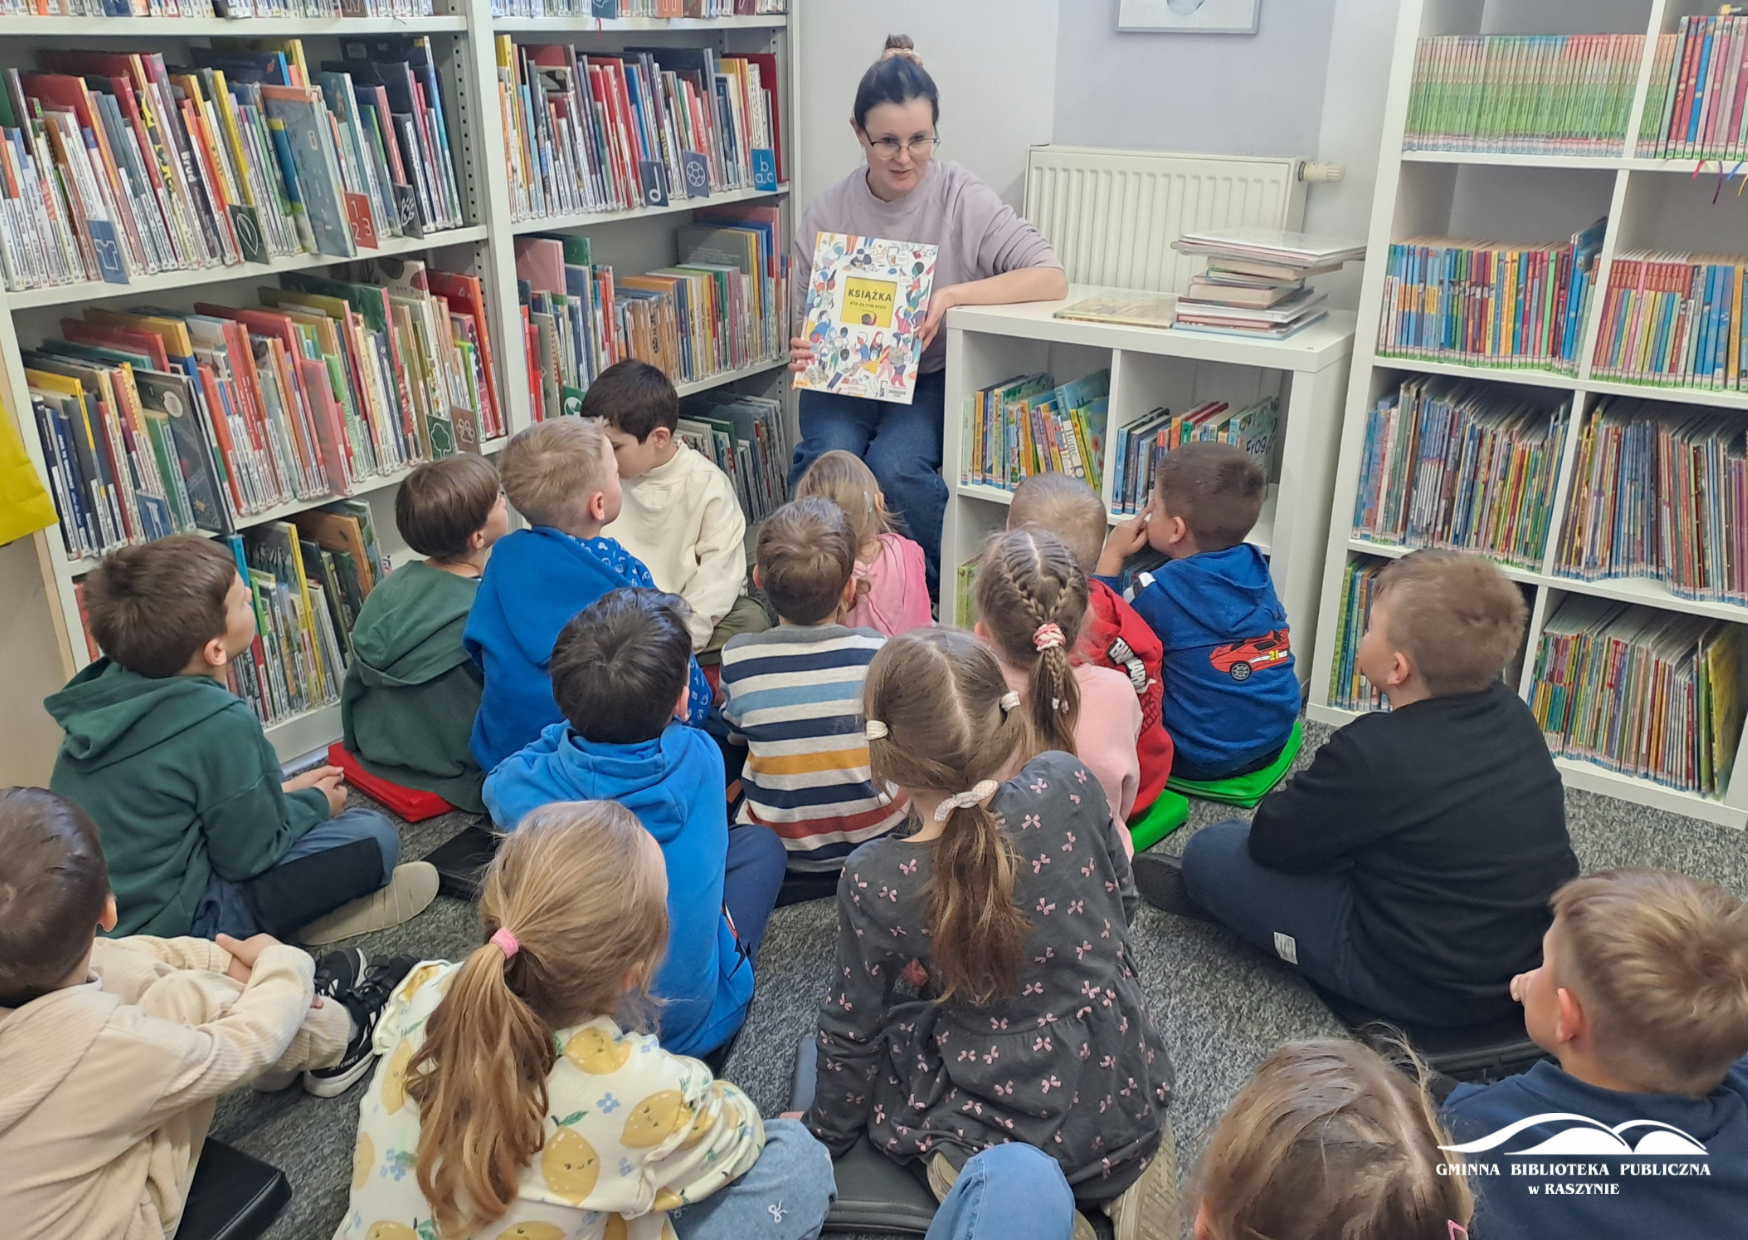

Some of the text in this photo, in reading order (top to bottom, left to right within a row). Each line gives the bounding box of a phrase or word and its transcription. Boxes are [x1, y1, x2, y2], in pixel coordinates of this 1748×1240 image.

[181, 151, 196, 182] Brud
[848, 288, 892, 302] KSIĄŻKA
[1065, 429, 1078, 457] Home
[1268, 650, 1280, 661] 21
